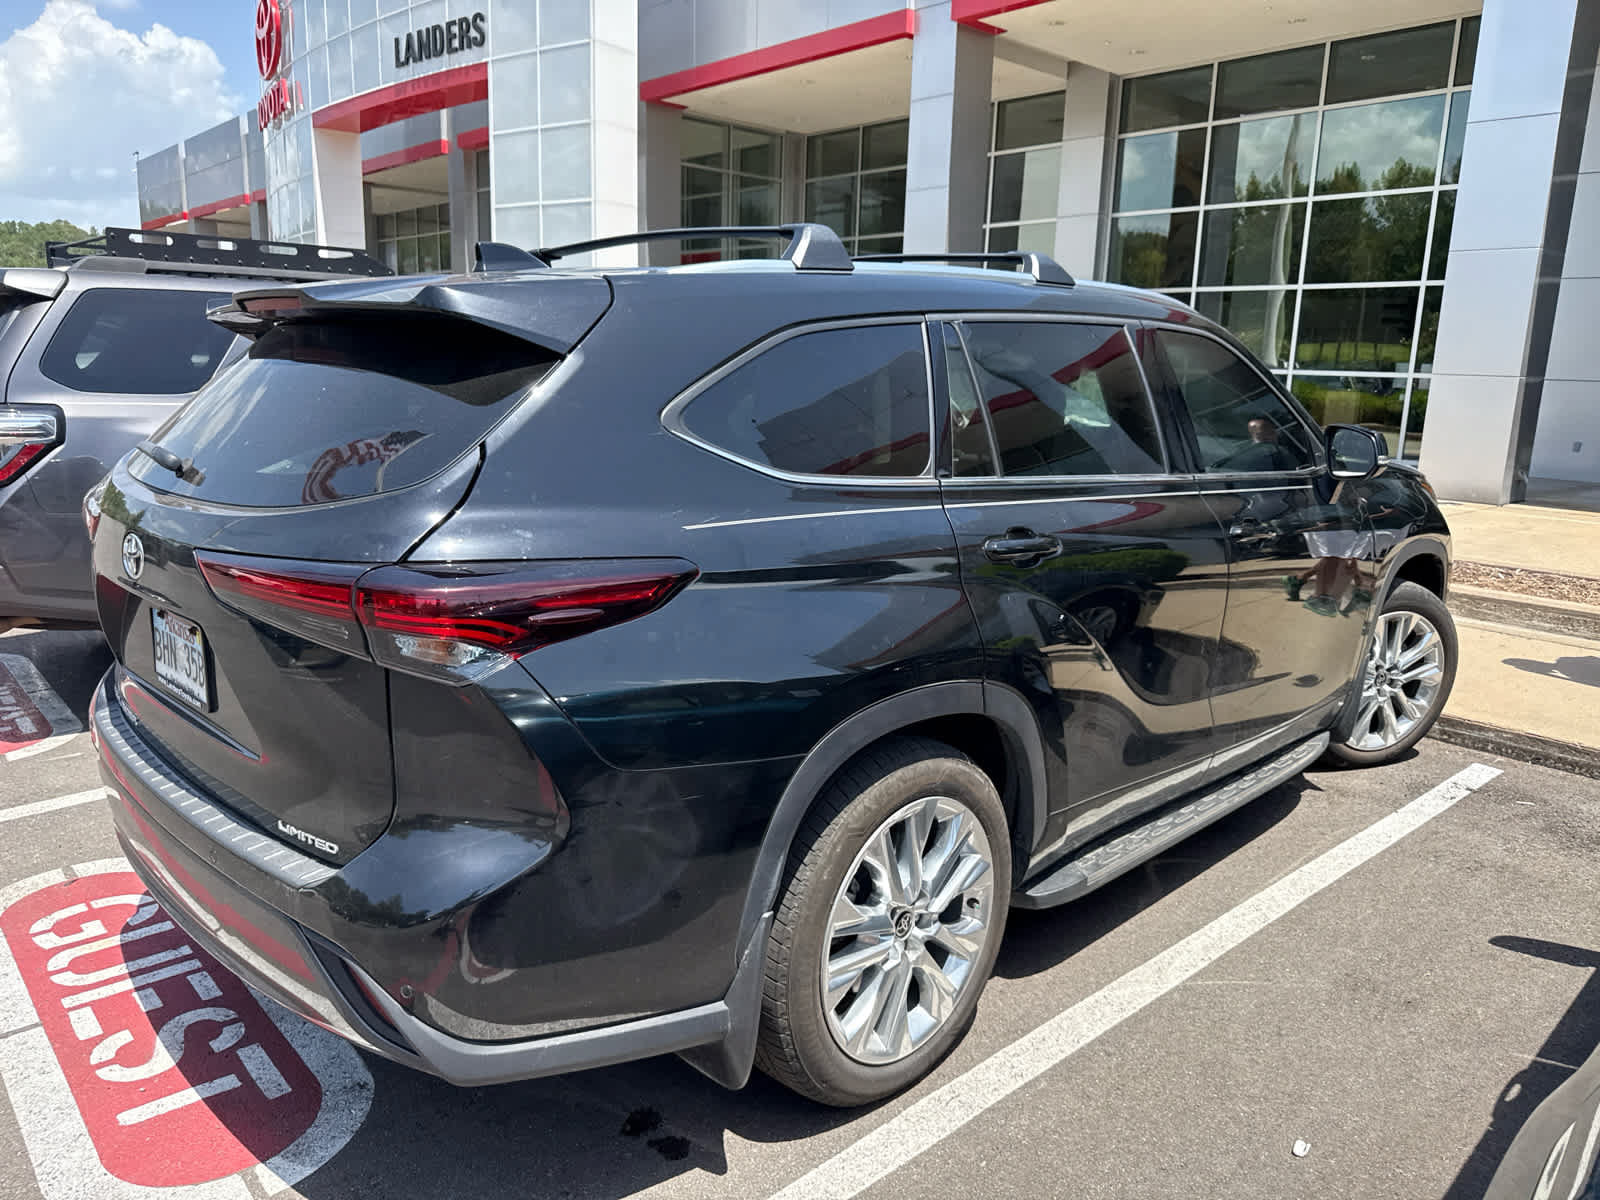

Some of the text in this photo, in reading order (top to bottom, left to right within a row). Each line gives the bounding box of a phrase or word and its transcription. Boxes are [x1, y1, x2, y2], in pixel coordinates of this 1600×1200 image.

[394, 12, 485, 68] LANDERS
[154, 626, 178, 672] BHN
[277, 819, 339, 855] LIMITED
[28, 893, 293, 1126] GUEST
